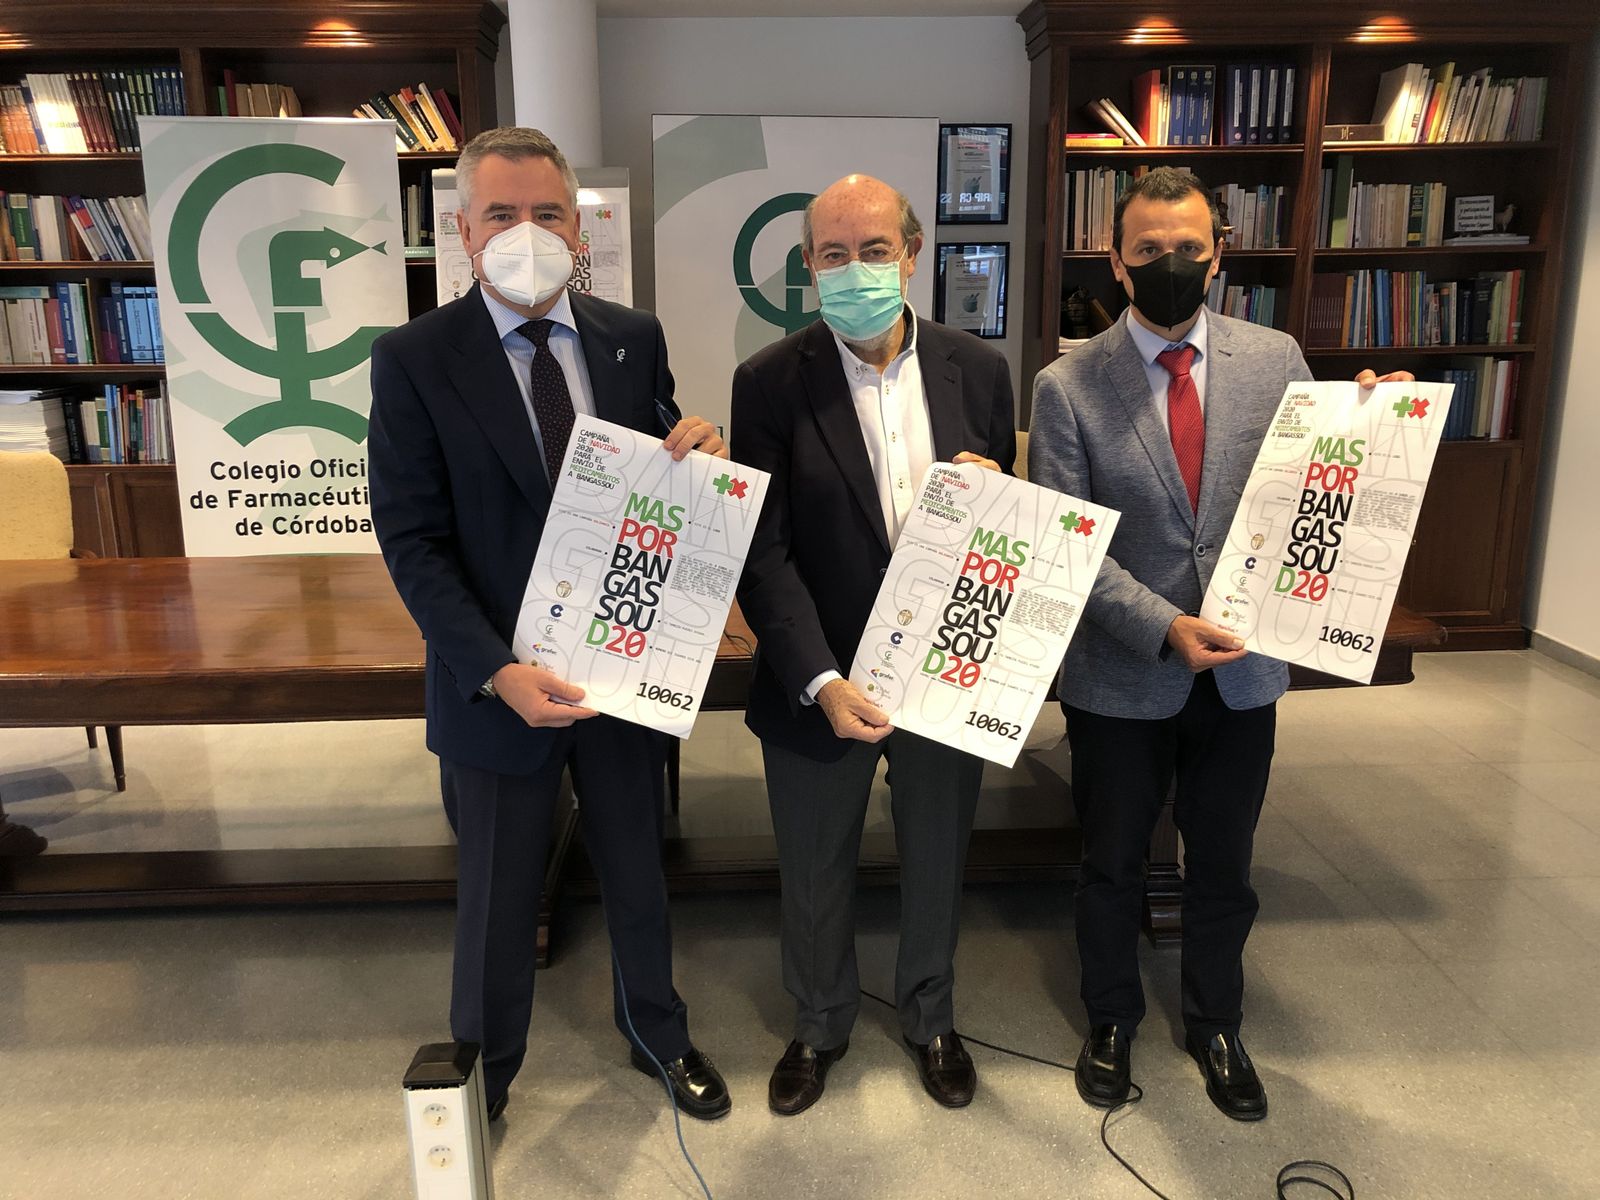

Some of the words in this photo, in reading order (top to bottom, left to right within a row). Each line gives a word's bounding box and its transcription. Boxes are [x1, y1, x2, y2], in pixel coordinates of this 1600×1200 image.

[576, 443, 594, 453] 2020
[580, 429, 609, 443] CAMPAÑA
[590, 440, 620, 454] NAVIDAD
[572, 457, 593, 468] ENVÍO
[574, 450, 591, 460] PARA
[1311, 436, 1366, 466] MAS
[210, 460, 301, 483] Colegio
[310, 458, 366, 478] Ofici
[570, 464, 620, 484] MEDICAMENTOS
[576, 474, 615, 489] BANGASSOU
[928, 479, 945, 489] 2020
[934, 468, 960, 479] CAMPAÑA
[942, 476, 970, 490] NAVIDAD
[1304, 462, 1358, 495] POR
[190, 490, 218, 509] de
[228, 486, 369, 508] Farmacéuti
[923, 491, 943, 503] ENVÍO
[926, 485, 941, 495] PARA
[624, 492, 685, 532] MAS
[921, 498, 967, 518] MEDICAMENTOS
[926, 507, 961, 523] BANGASSOU
[1297, 489, 1354, 521] BAN
[235, 517, 263, 536] de
[272, 515, 372, 535] Córdoba
[617, 518, 678, 559] POR
[1291, 516, 1345, 548] GAS
[968, 527, 1029, 567] MAS
[1282, 542, 1338, 575] SOU
[610, 543, 673, 584] BAN
[960, 552, 1020, 593] POR
[603, 570, 663, 607] GAS
[951, 576, 1013, 616] BAN
[1275, 567, 1329, 602] D20
[594, 594, 657, 633] SOU
[942, 602, 1002, 639] GAS
[586, 619, 648, 658] D20
[932, 626, 993, 664] SOU
[1319, 626, 1374, 653] 10062
[921, 647, 981, 688] D20
[636, 682, 693, 711] 10062
[965, 711, 1021, 740] 10062
